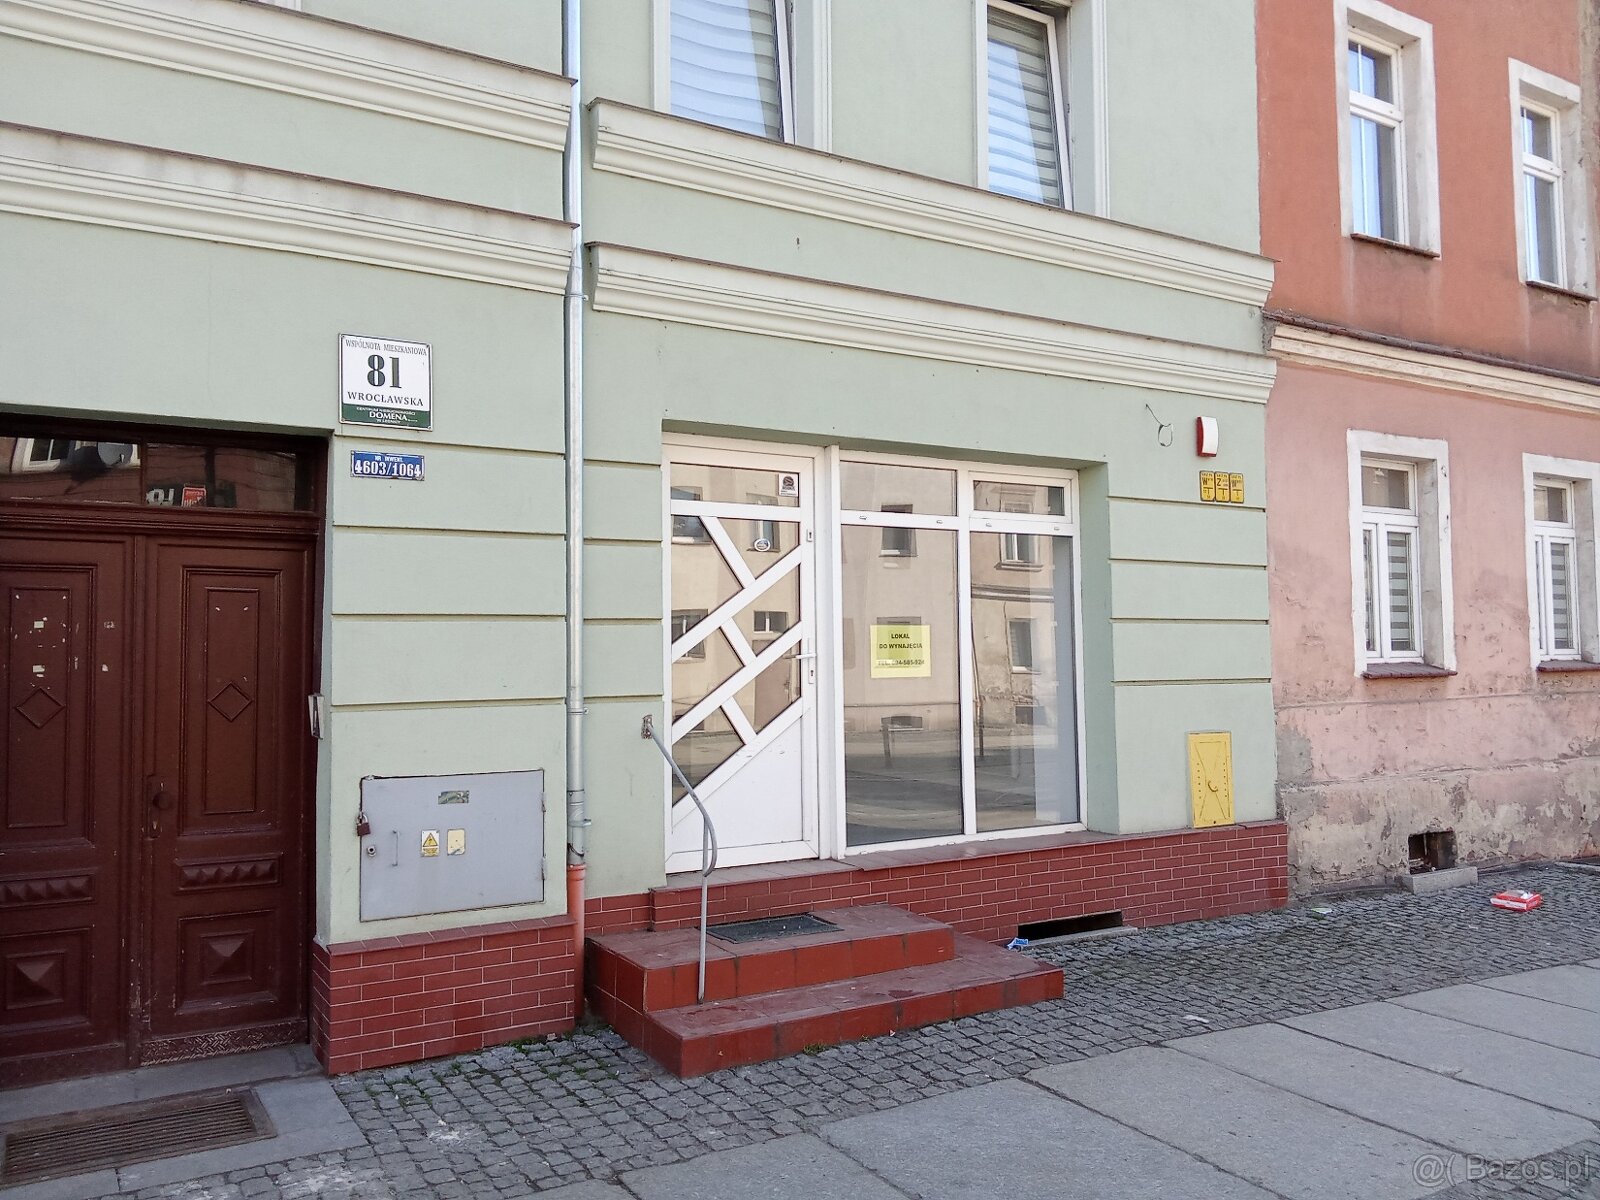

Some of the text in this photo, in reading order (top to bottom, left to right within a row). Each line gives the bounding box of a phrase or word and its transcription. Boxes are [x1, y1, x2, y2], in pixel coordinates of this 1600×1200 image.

[345, 339, 428, 356] WSPÓLNOTA MIESZKANIOWA
[367, 354, 402, 389] 81
[369, 410, 408, 421] DOMENA
[355, 459, 421, 478] 4603/1064
